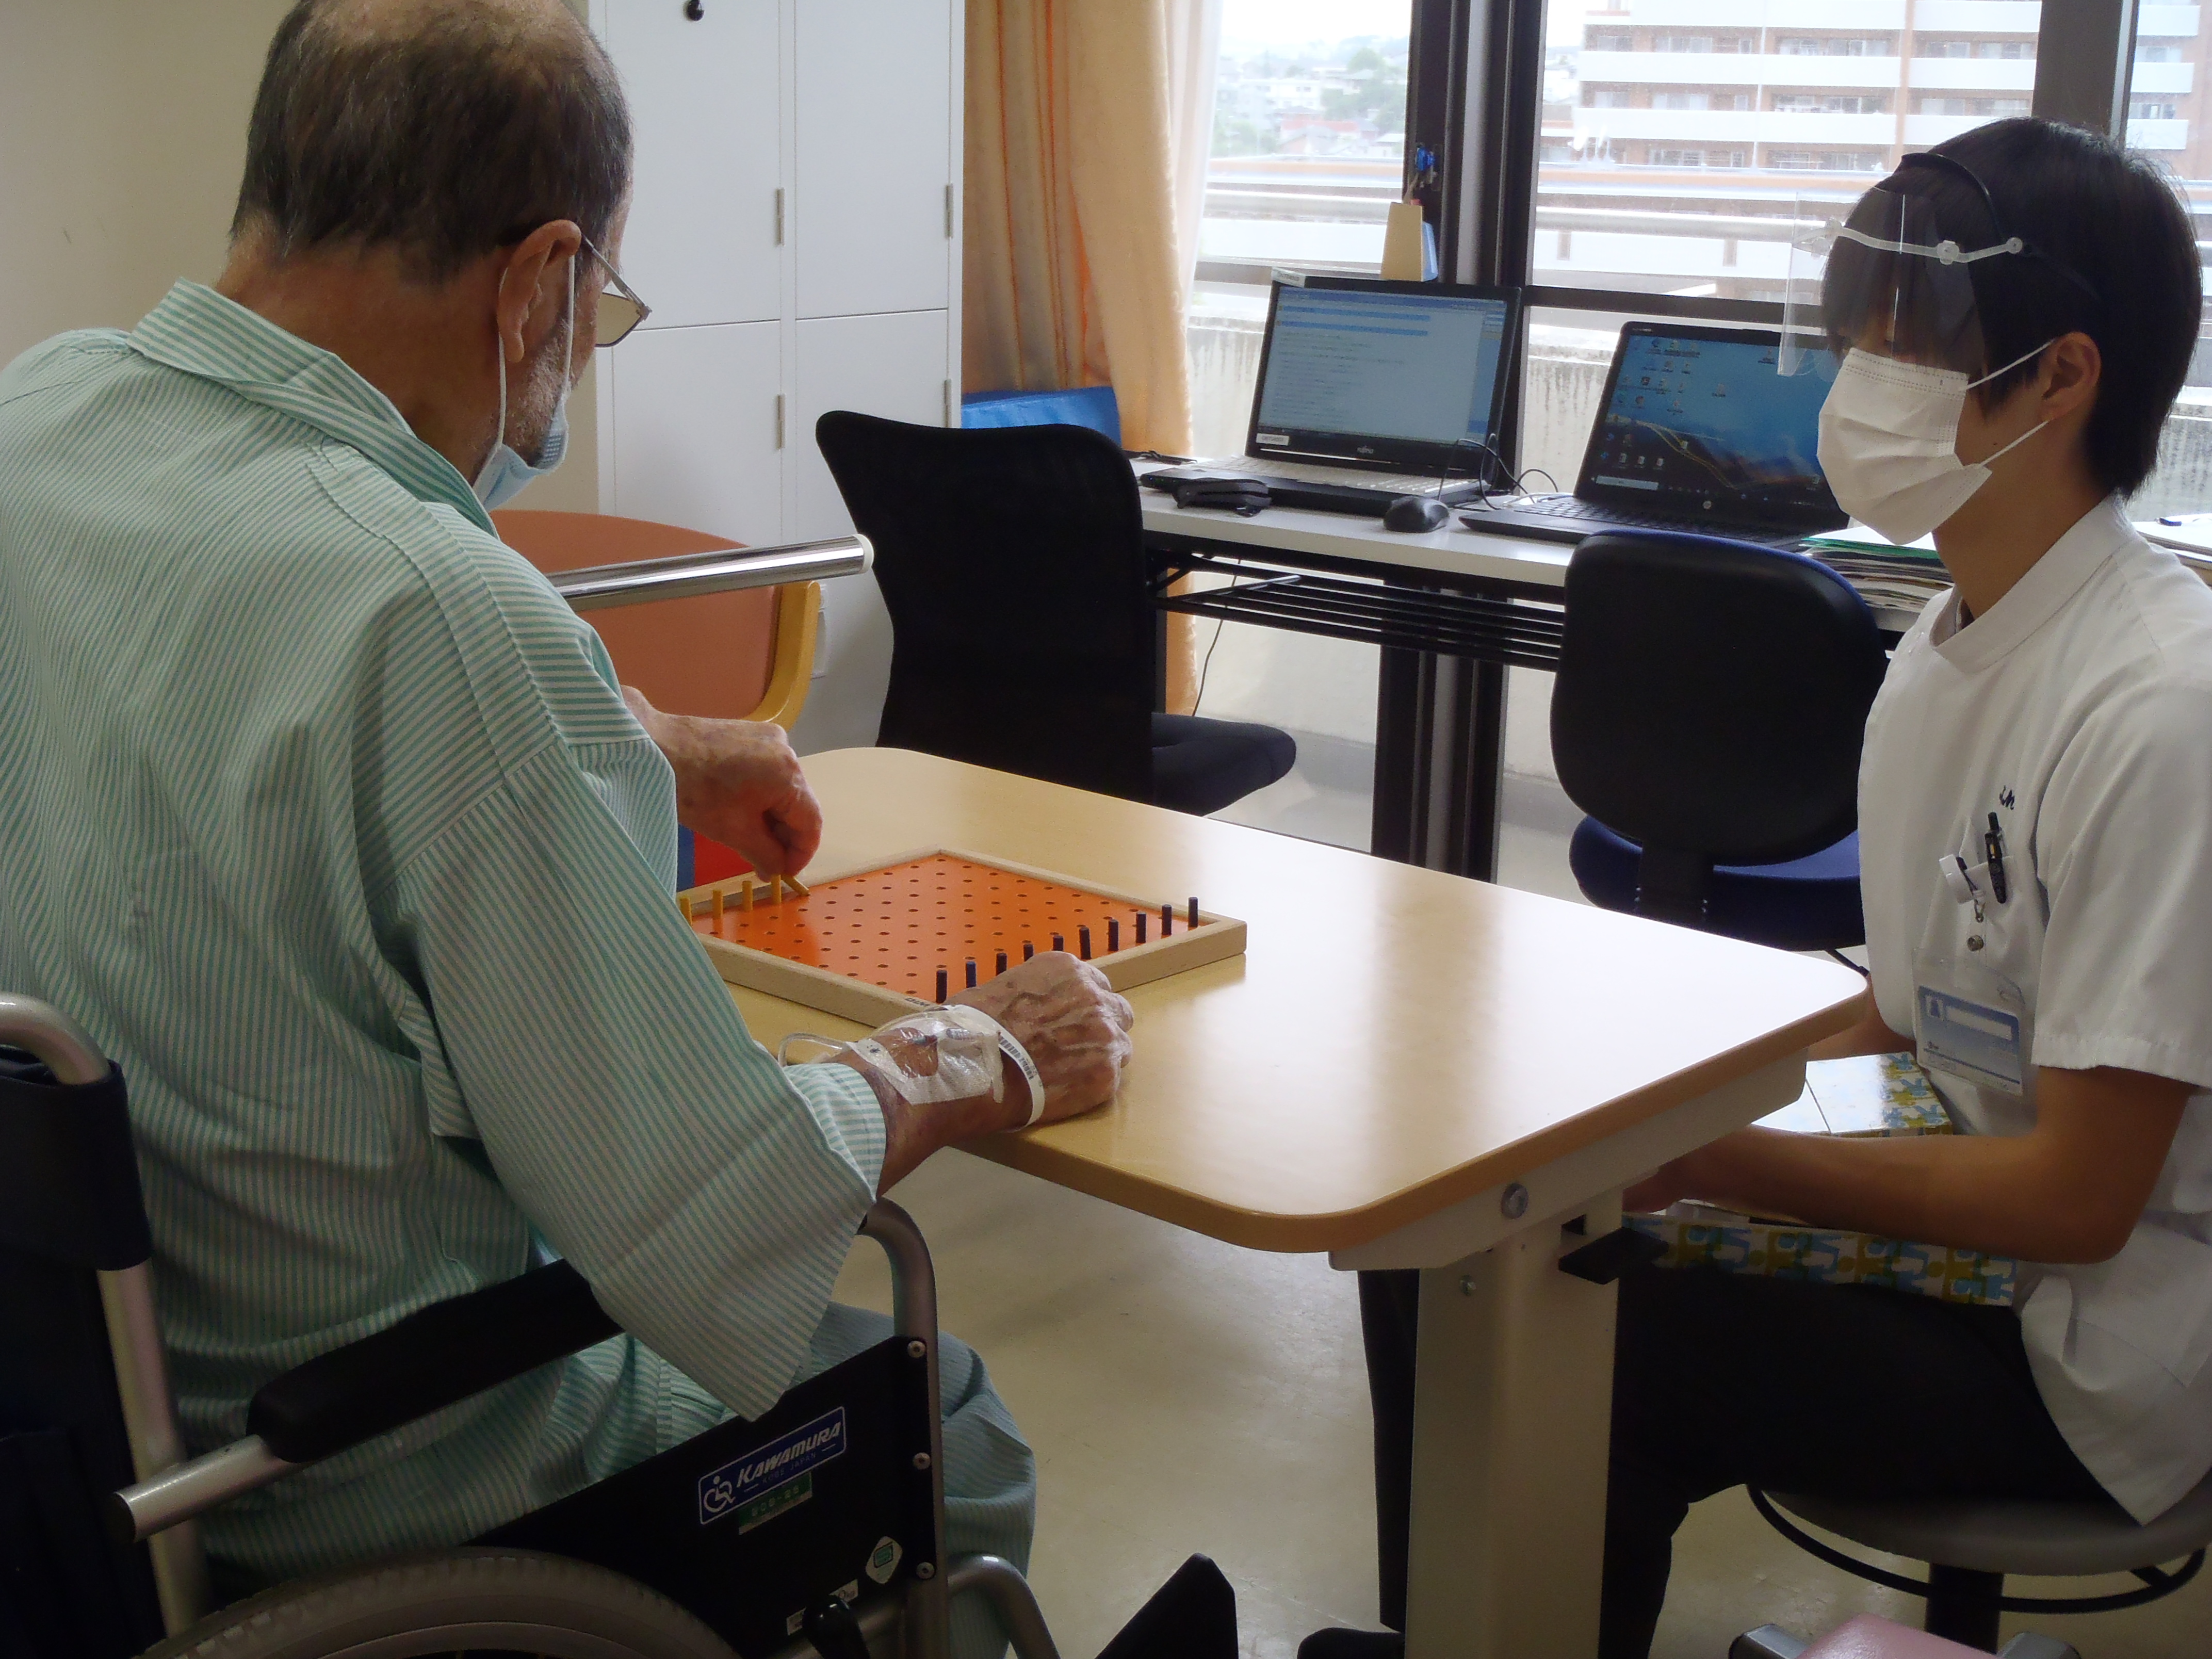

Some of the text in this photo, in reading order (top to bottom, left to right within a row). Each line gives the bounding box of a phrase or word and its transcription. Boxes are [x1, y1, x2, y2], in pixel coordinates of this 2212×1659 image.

[736, 1421, 841, 1488] KAWAMURA
[762, 1453, 816, 1483] KOBE JAPAN
